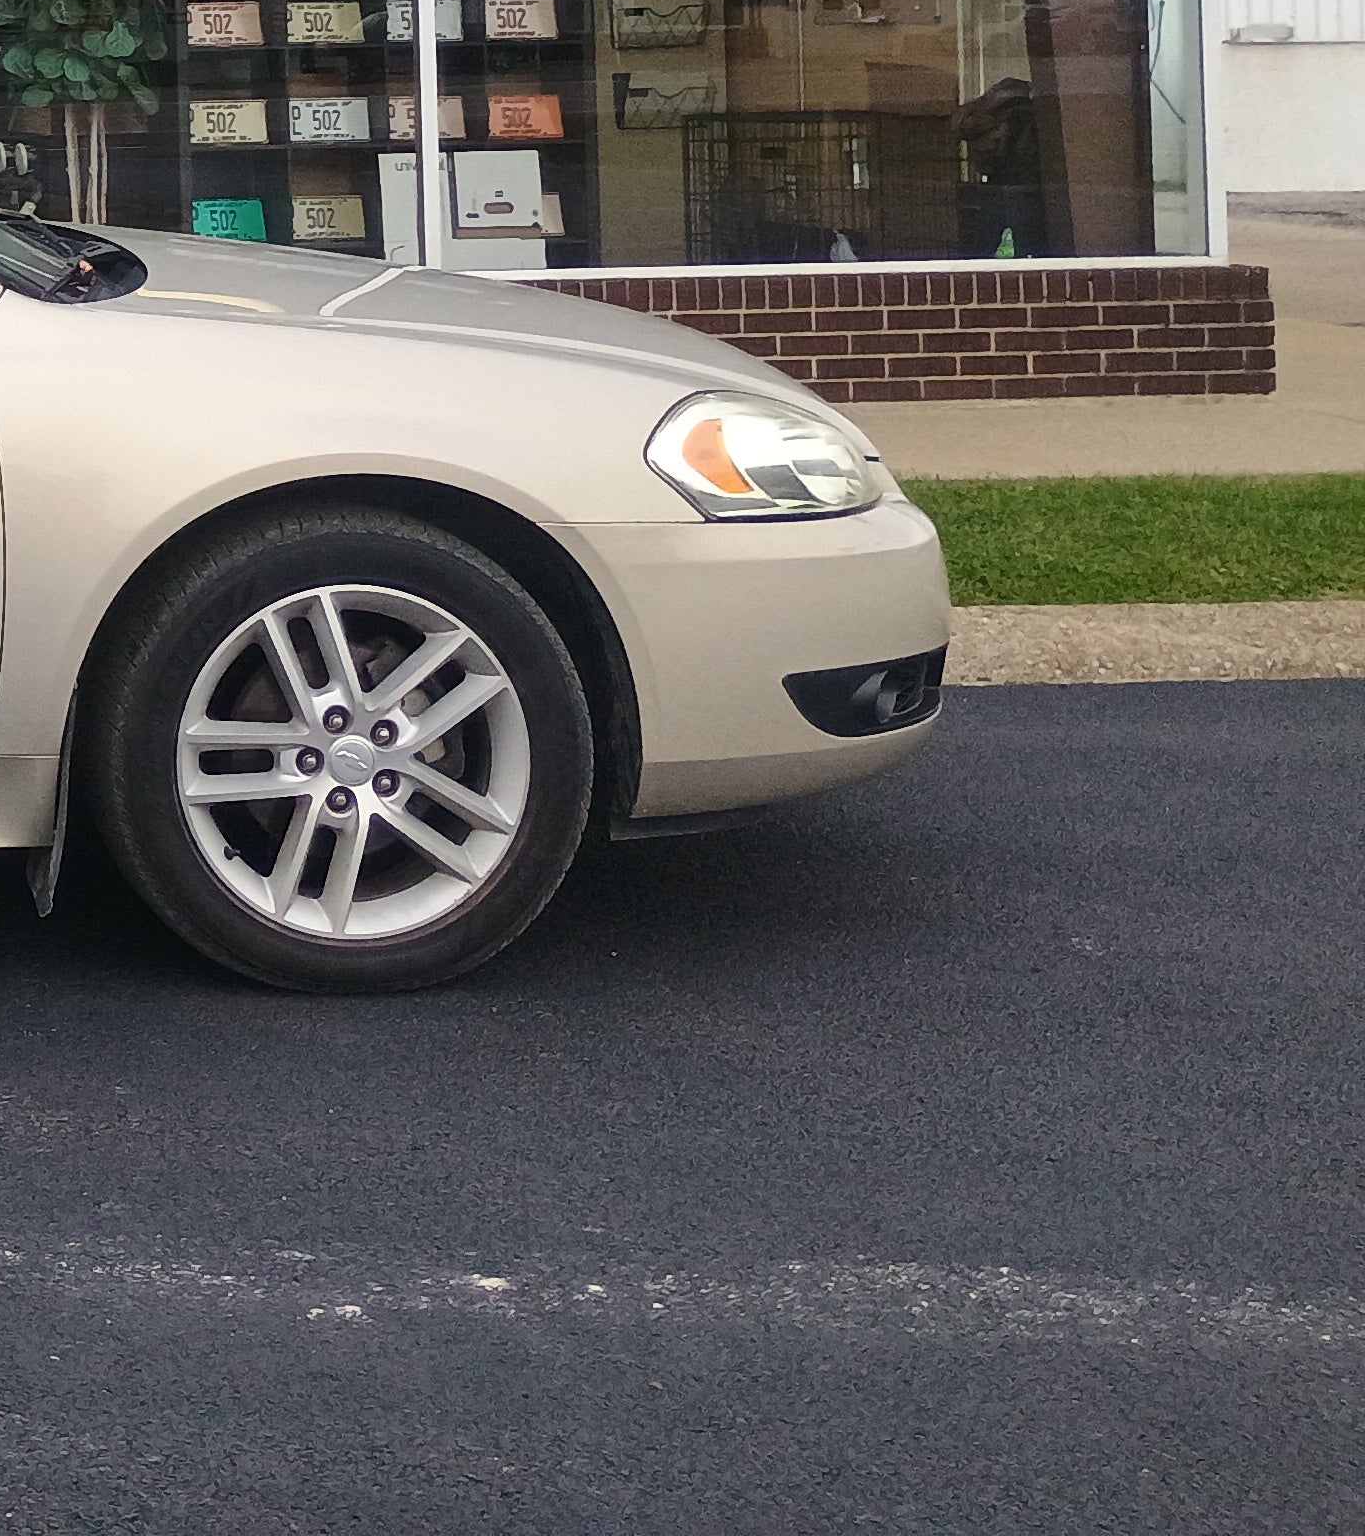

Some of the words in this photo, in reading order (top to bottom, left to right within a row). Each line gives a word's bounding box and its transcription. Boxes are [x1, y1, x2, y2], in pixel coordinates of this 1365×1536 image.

[203, 13, 234, 35] 502
[303, 11, 334, 33] 502
[496, 7, 528, 29] 502
[206, 111, 236, 133] 502
[312, 109, 342, 131] 502
[209, 209, 239, 232] 502
[306, 207, 337, 229] 502
